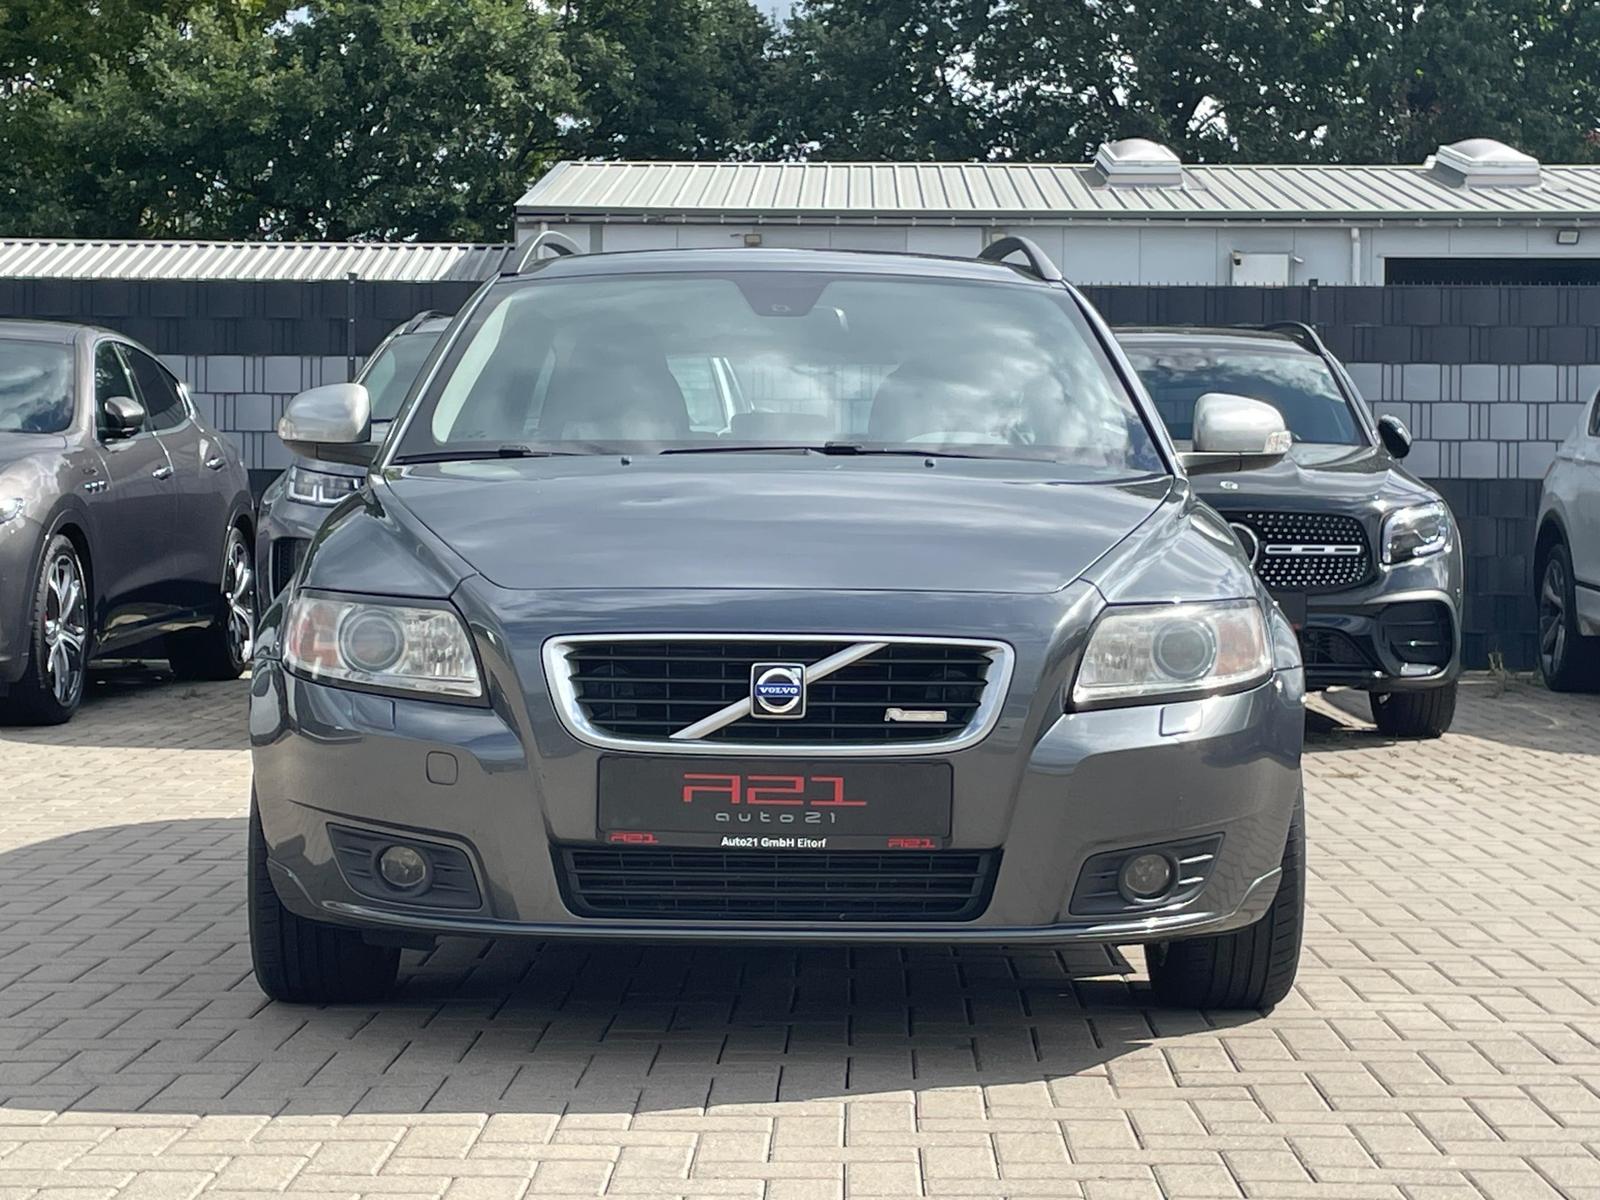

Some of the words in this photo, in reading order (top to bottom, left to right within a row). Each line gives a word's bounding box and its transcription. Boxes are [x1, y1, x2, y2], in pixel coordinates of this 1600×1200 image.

[683, 773, 867, 806] A21
[721, 836, 758, 847] Auto21
[761, 837, 795, 848] GmbH
[797, 838, 827, 848] Eitorf
